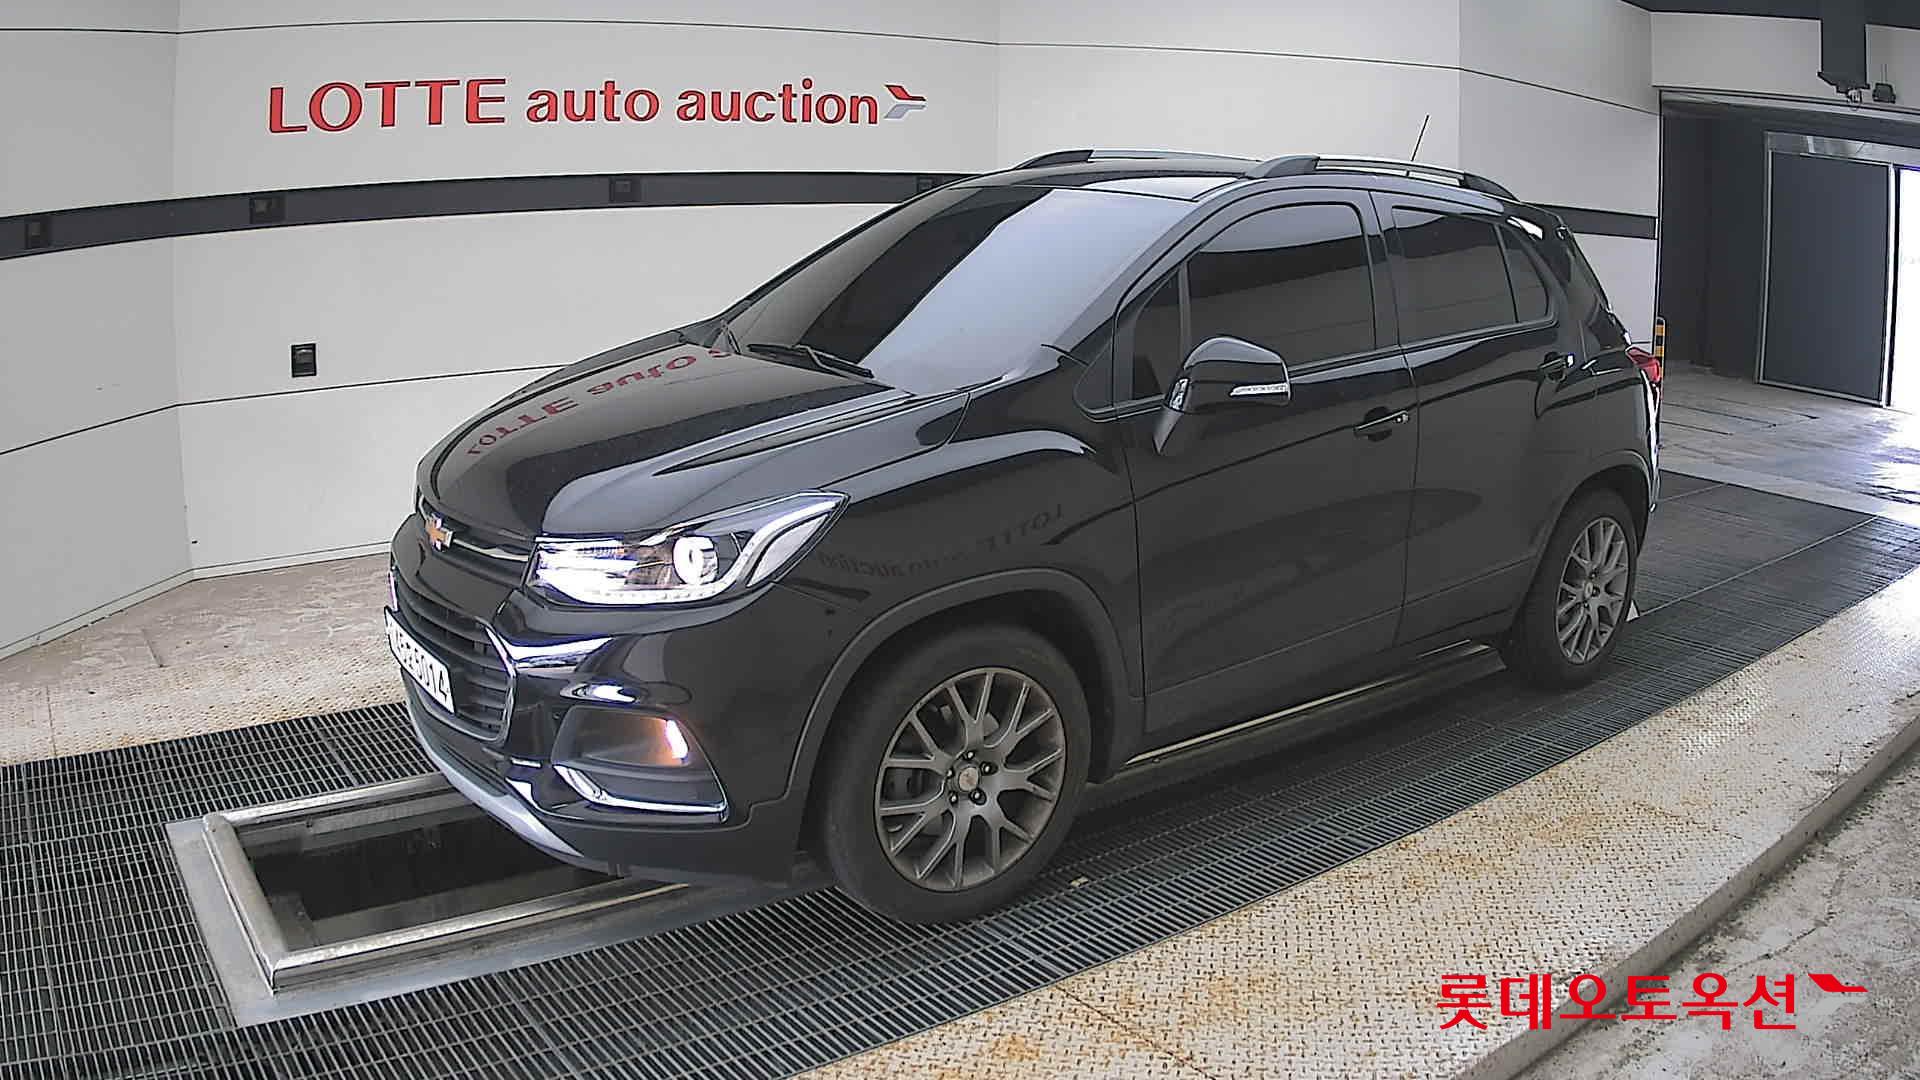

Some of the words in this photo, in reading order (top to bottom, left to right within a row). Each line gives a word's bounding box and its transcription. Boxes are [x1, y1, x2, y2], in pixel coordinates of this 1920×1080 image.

[268, 78, 507, 134] LOTTE
[526, 80, 661, 124] auto
[675, 78, 880, 125] auction
